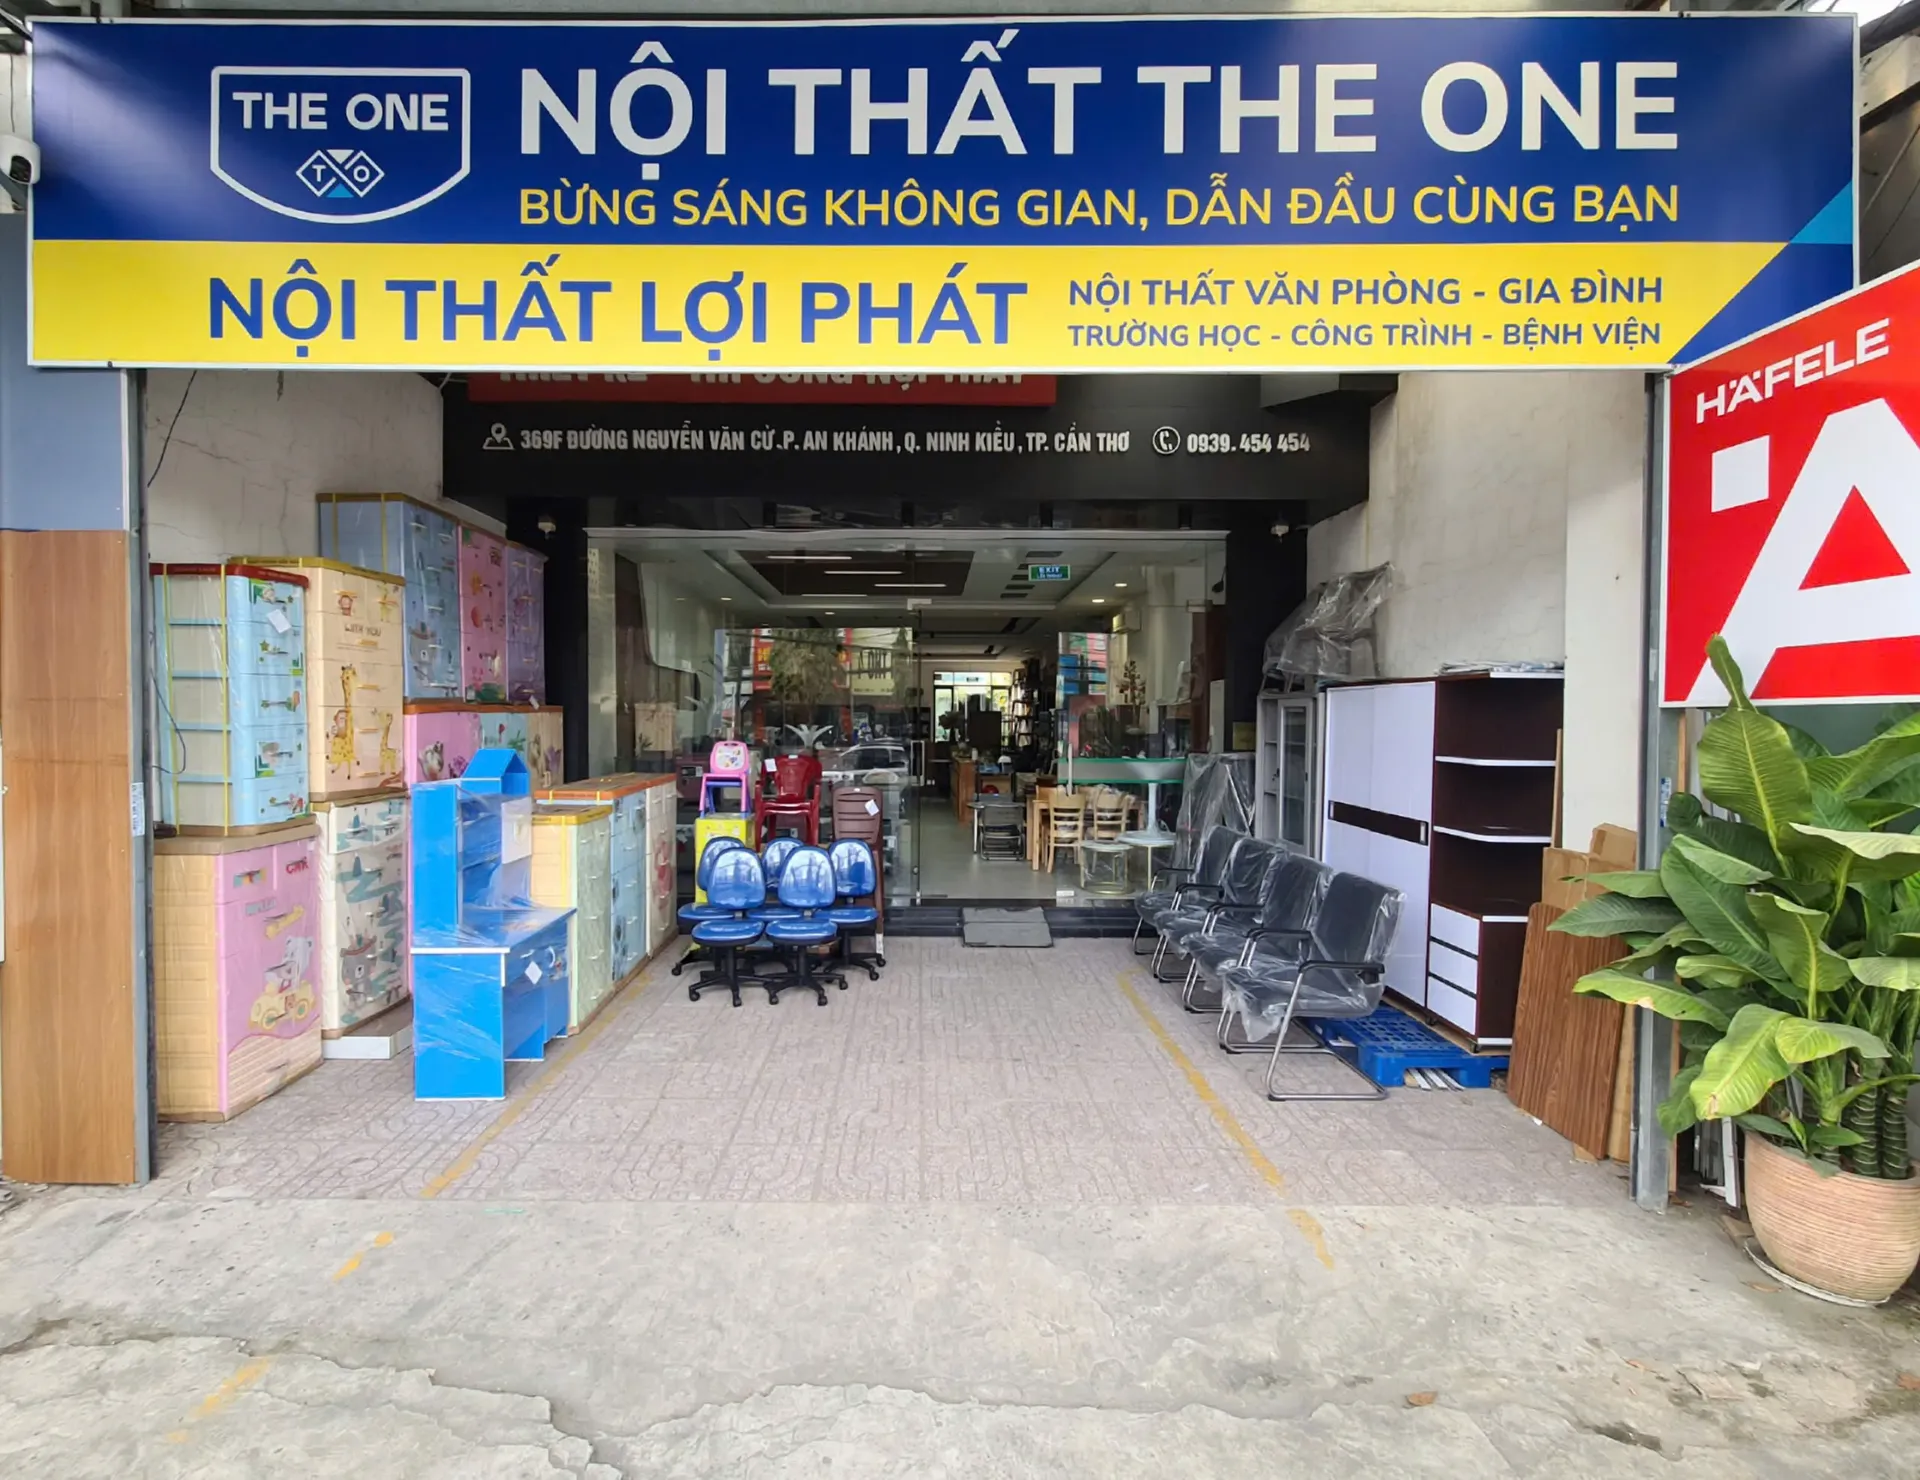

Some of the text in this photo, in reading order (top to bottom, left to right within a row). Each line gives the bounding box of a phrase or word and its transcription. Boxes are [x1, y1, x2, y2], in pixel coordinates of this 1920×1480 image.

[232, 92, 449, 131] THE ONE
[520, 29, 1678, 181] NỘI THẤT THE ONE
[520, 172, 1678, 232] BỪNG SÁNG KHÔNG GIAN, DẪN ĐẦU CÙNG BẠN
[209, 254, 1028, 360] NỘI THẤT LỢI PHÁT
[1069, 272, 1131, 313] NỘI
[1141, 268, 1235, 306] THẤT
[1245, 271, 1320, 305] VĂN
[1332, 270, 1461, 305] PHÒNG
[1498, 277, 1561, 304] GIA
[1570, 268, 1663, 304] ĐÌNH
[1067, 318, 1189, 347] TRƯỜNG
[1199, 324, 1261, 352] HỌC
[1291, 318, 1373, 346] CÔNG
[1382, 317, 1472, 346] TRÌNH
[1503, 316, 1583, 351] BỆNH
[1592, 315, 1661, 351] VIỆN
[1695, 317, 1890, 424] HÄFELE
[520, 429, 563, 449] 369F
[567, 424, 629, 450] ĐƯỜNG
[632, 420, 704, 450] NGUYỄN
[709, 425, 745, 450] VĂN
[803, 430, 828, 451] AN
[926, 431, 970, 452] NINH
[1095, 430, 1130, 452] THƠ
[1277, 432, 1311, 453] 454
